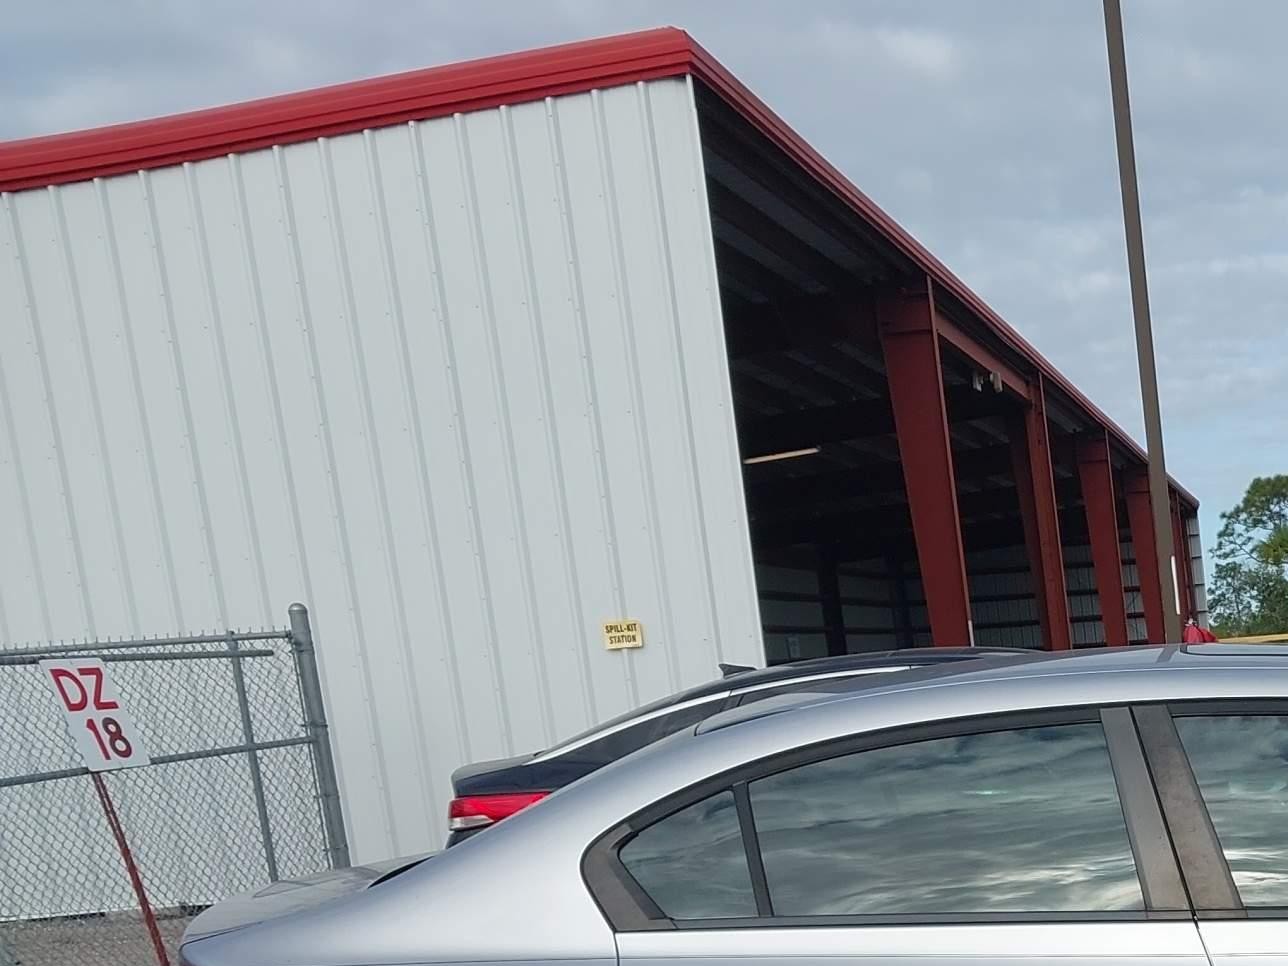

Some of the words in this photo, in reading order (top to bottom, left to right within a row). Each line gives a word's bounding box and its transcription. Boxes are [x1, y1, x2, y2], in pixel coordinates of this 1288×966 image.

[605, 623, 637, 634] SPILL-KIT
[609, 634, 637, 645] STATION
[49, 667, 119, 711] DZ
[86, 717, 132, 760] 18
